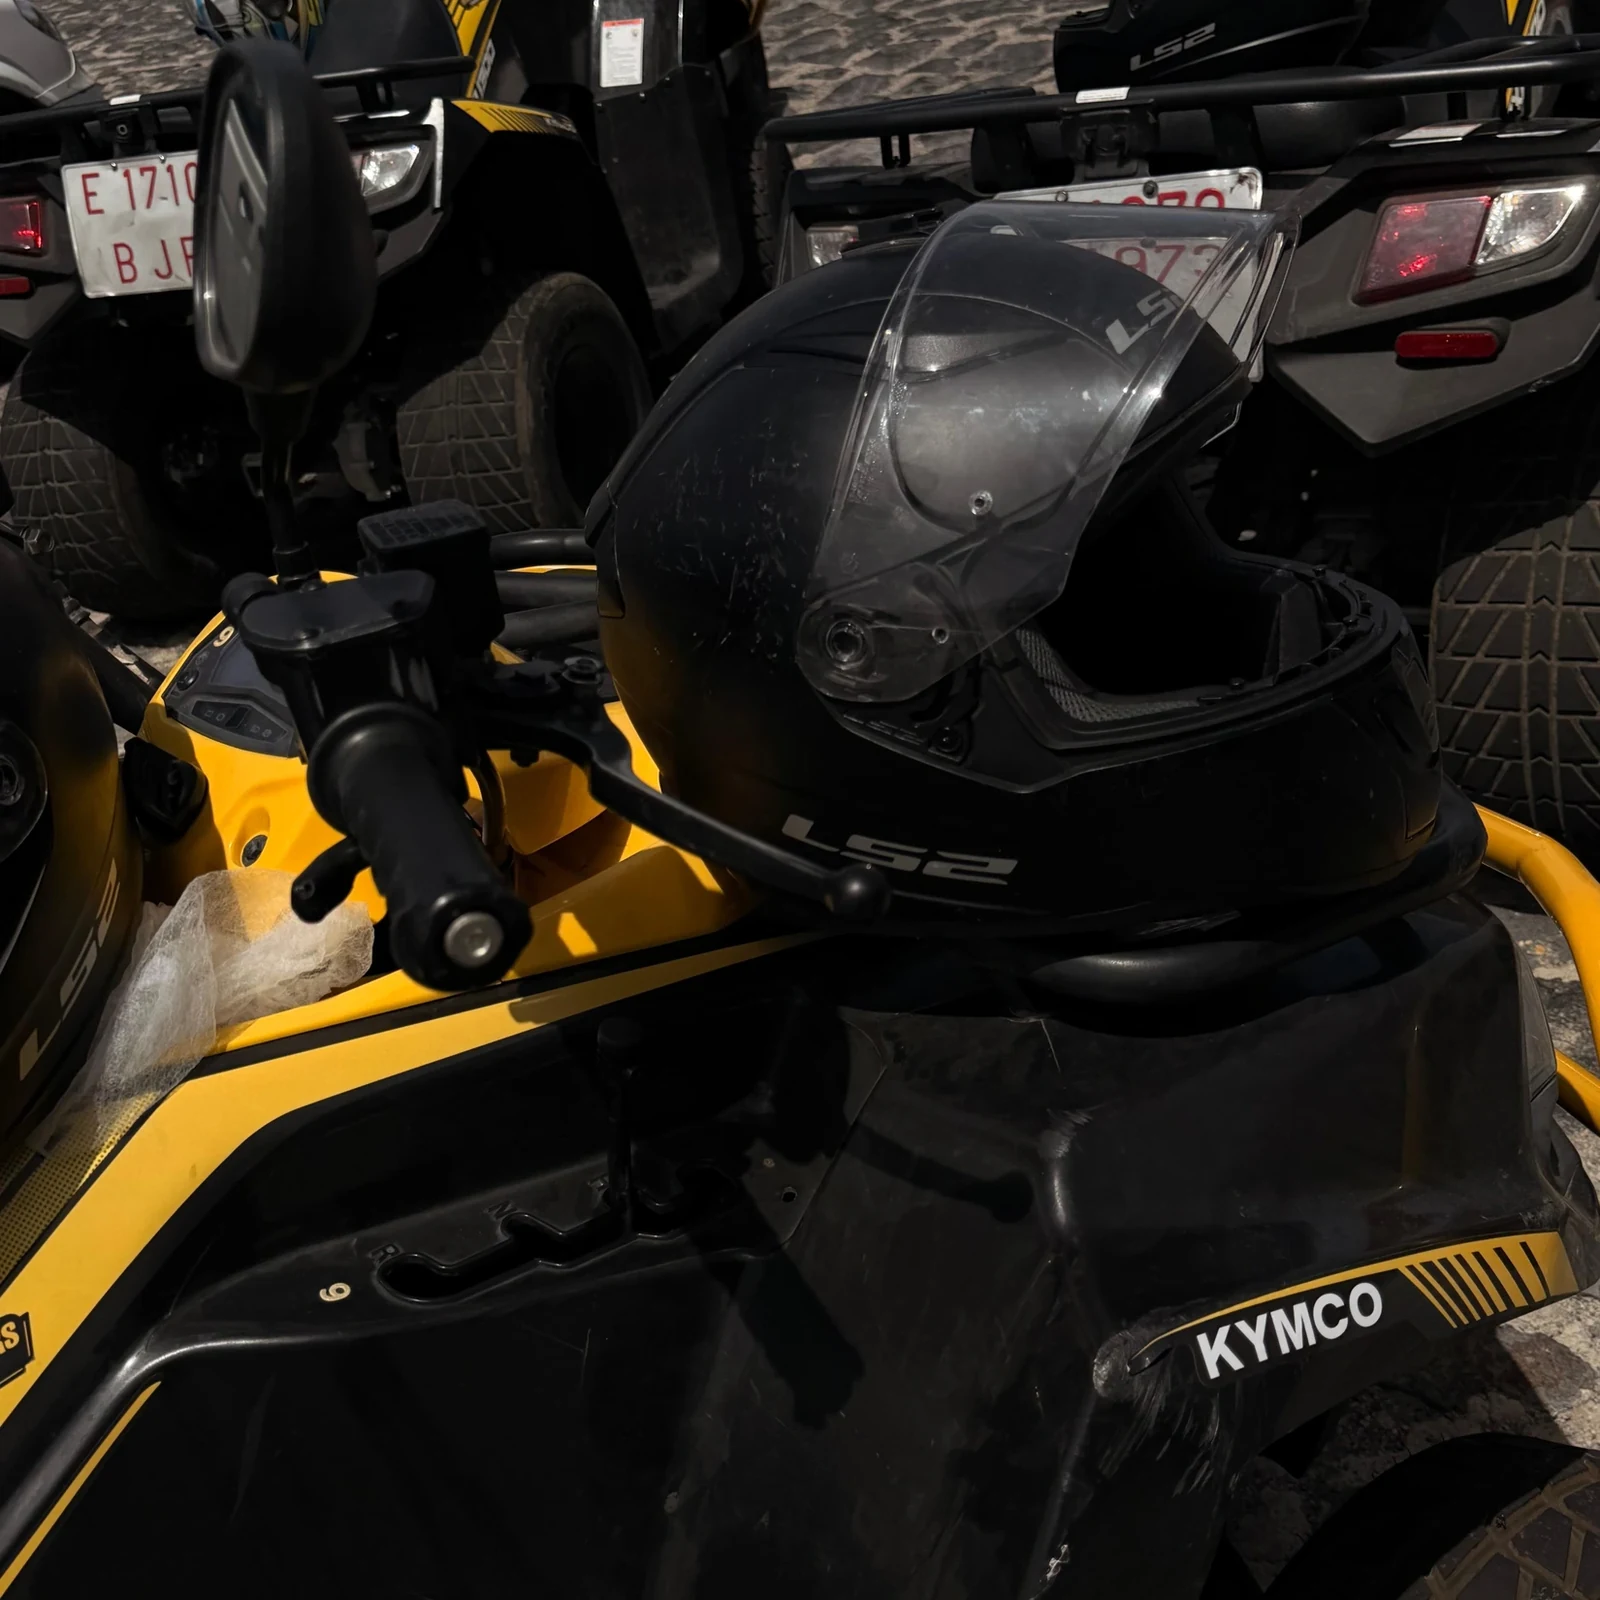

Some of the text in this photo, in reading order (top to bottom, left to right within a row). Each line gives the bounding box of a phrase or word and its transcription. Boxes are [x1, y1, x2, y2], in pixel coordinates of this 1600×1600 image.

[1129, 21, 1217, 72] LS2
[81, 172, 105, 215] E
[781, 813, 1019, 886] LS2
[19, 857, 121, 1083] LS2
[1196, 1282, 1383, 1380] KYMCO
